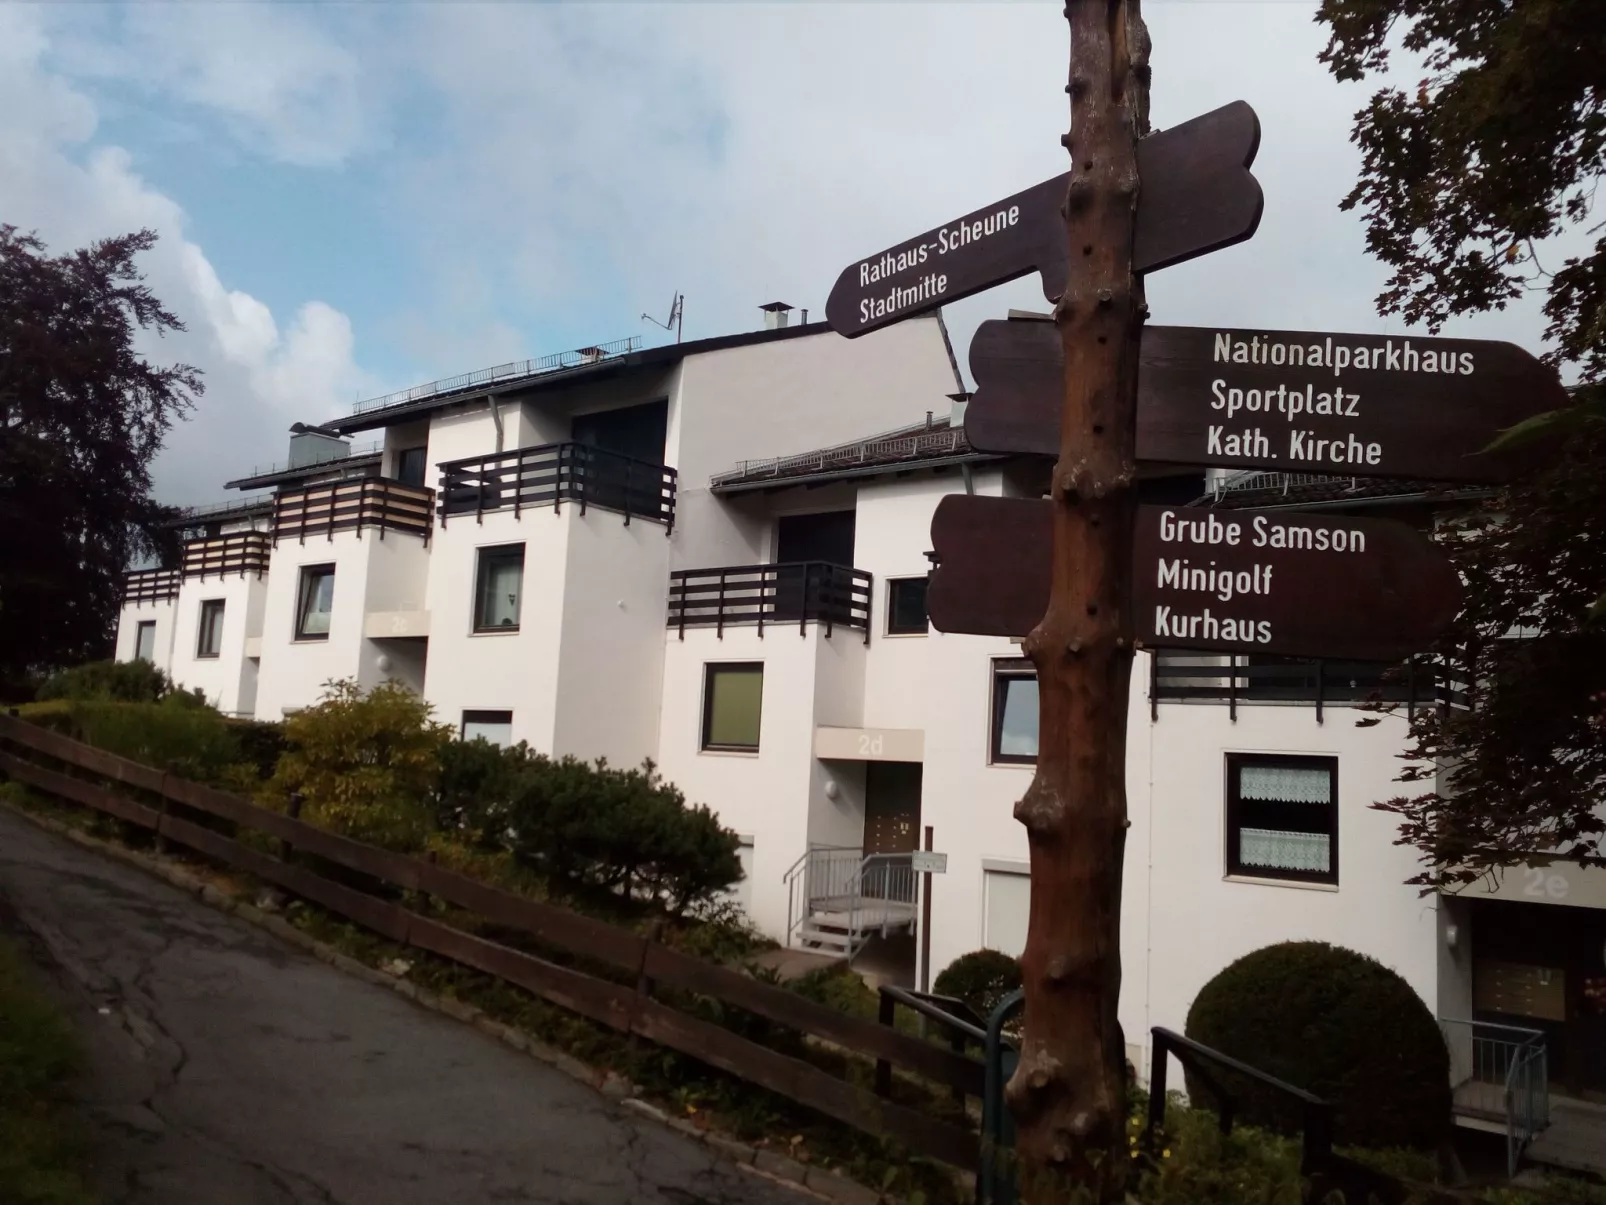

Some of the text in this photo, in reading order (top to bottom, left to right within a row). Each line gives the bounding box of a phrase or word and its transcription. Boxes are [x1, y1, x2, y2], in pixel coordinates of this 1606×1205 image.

[860, 205, 1019, 288] Rathaus-Scheune
[860, 273, 948, 323] Stadtmitte
[1214, 333, 1474, 376] Nationalparkhaus
[1210, 379, 1360, 422] Sportplatz
[1207, 425, 1382, 465] Kath. Kirche
[1160, 511, 1366, 552] Grube Samson
[1157, 558, 1273, 601] Minigolf
[1155, 605, 1272, 644] Kurhaus
[858, 734, 883, 755] 2d
[1523, 866, 1569, 899] 2e
